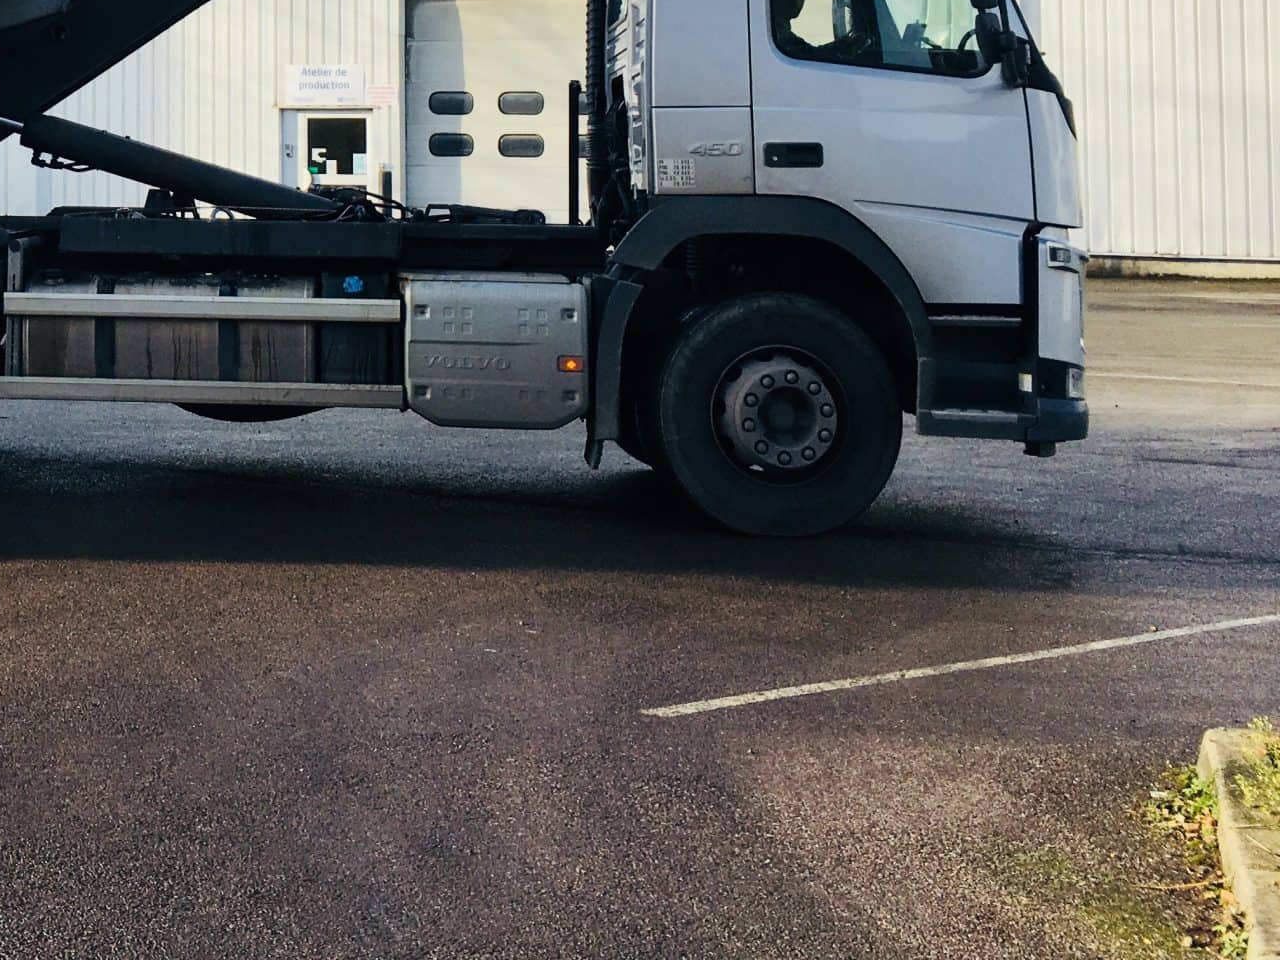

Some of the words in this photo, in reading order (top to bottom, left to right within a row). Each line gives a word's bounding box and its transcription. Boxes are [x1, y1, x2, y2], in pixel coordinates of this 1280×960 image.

[301, 67, 332, 77] Atelier
[335, 67, 348, 77] de
[298, 80, 351, 90] production
[688, 143, 743, 157] 450
[424, 353, 511, 371] VOLVO
